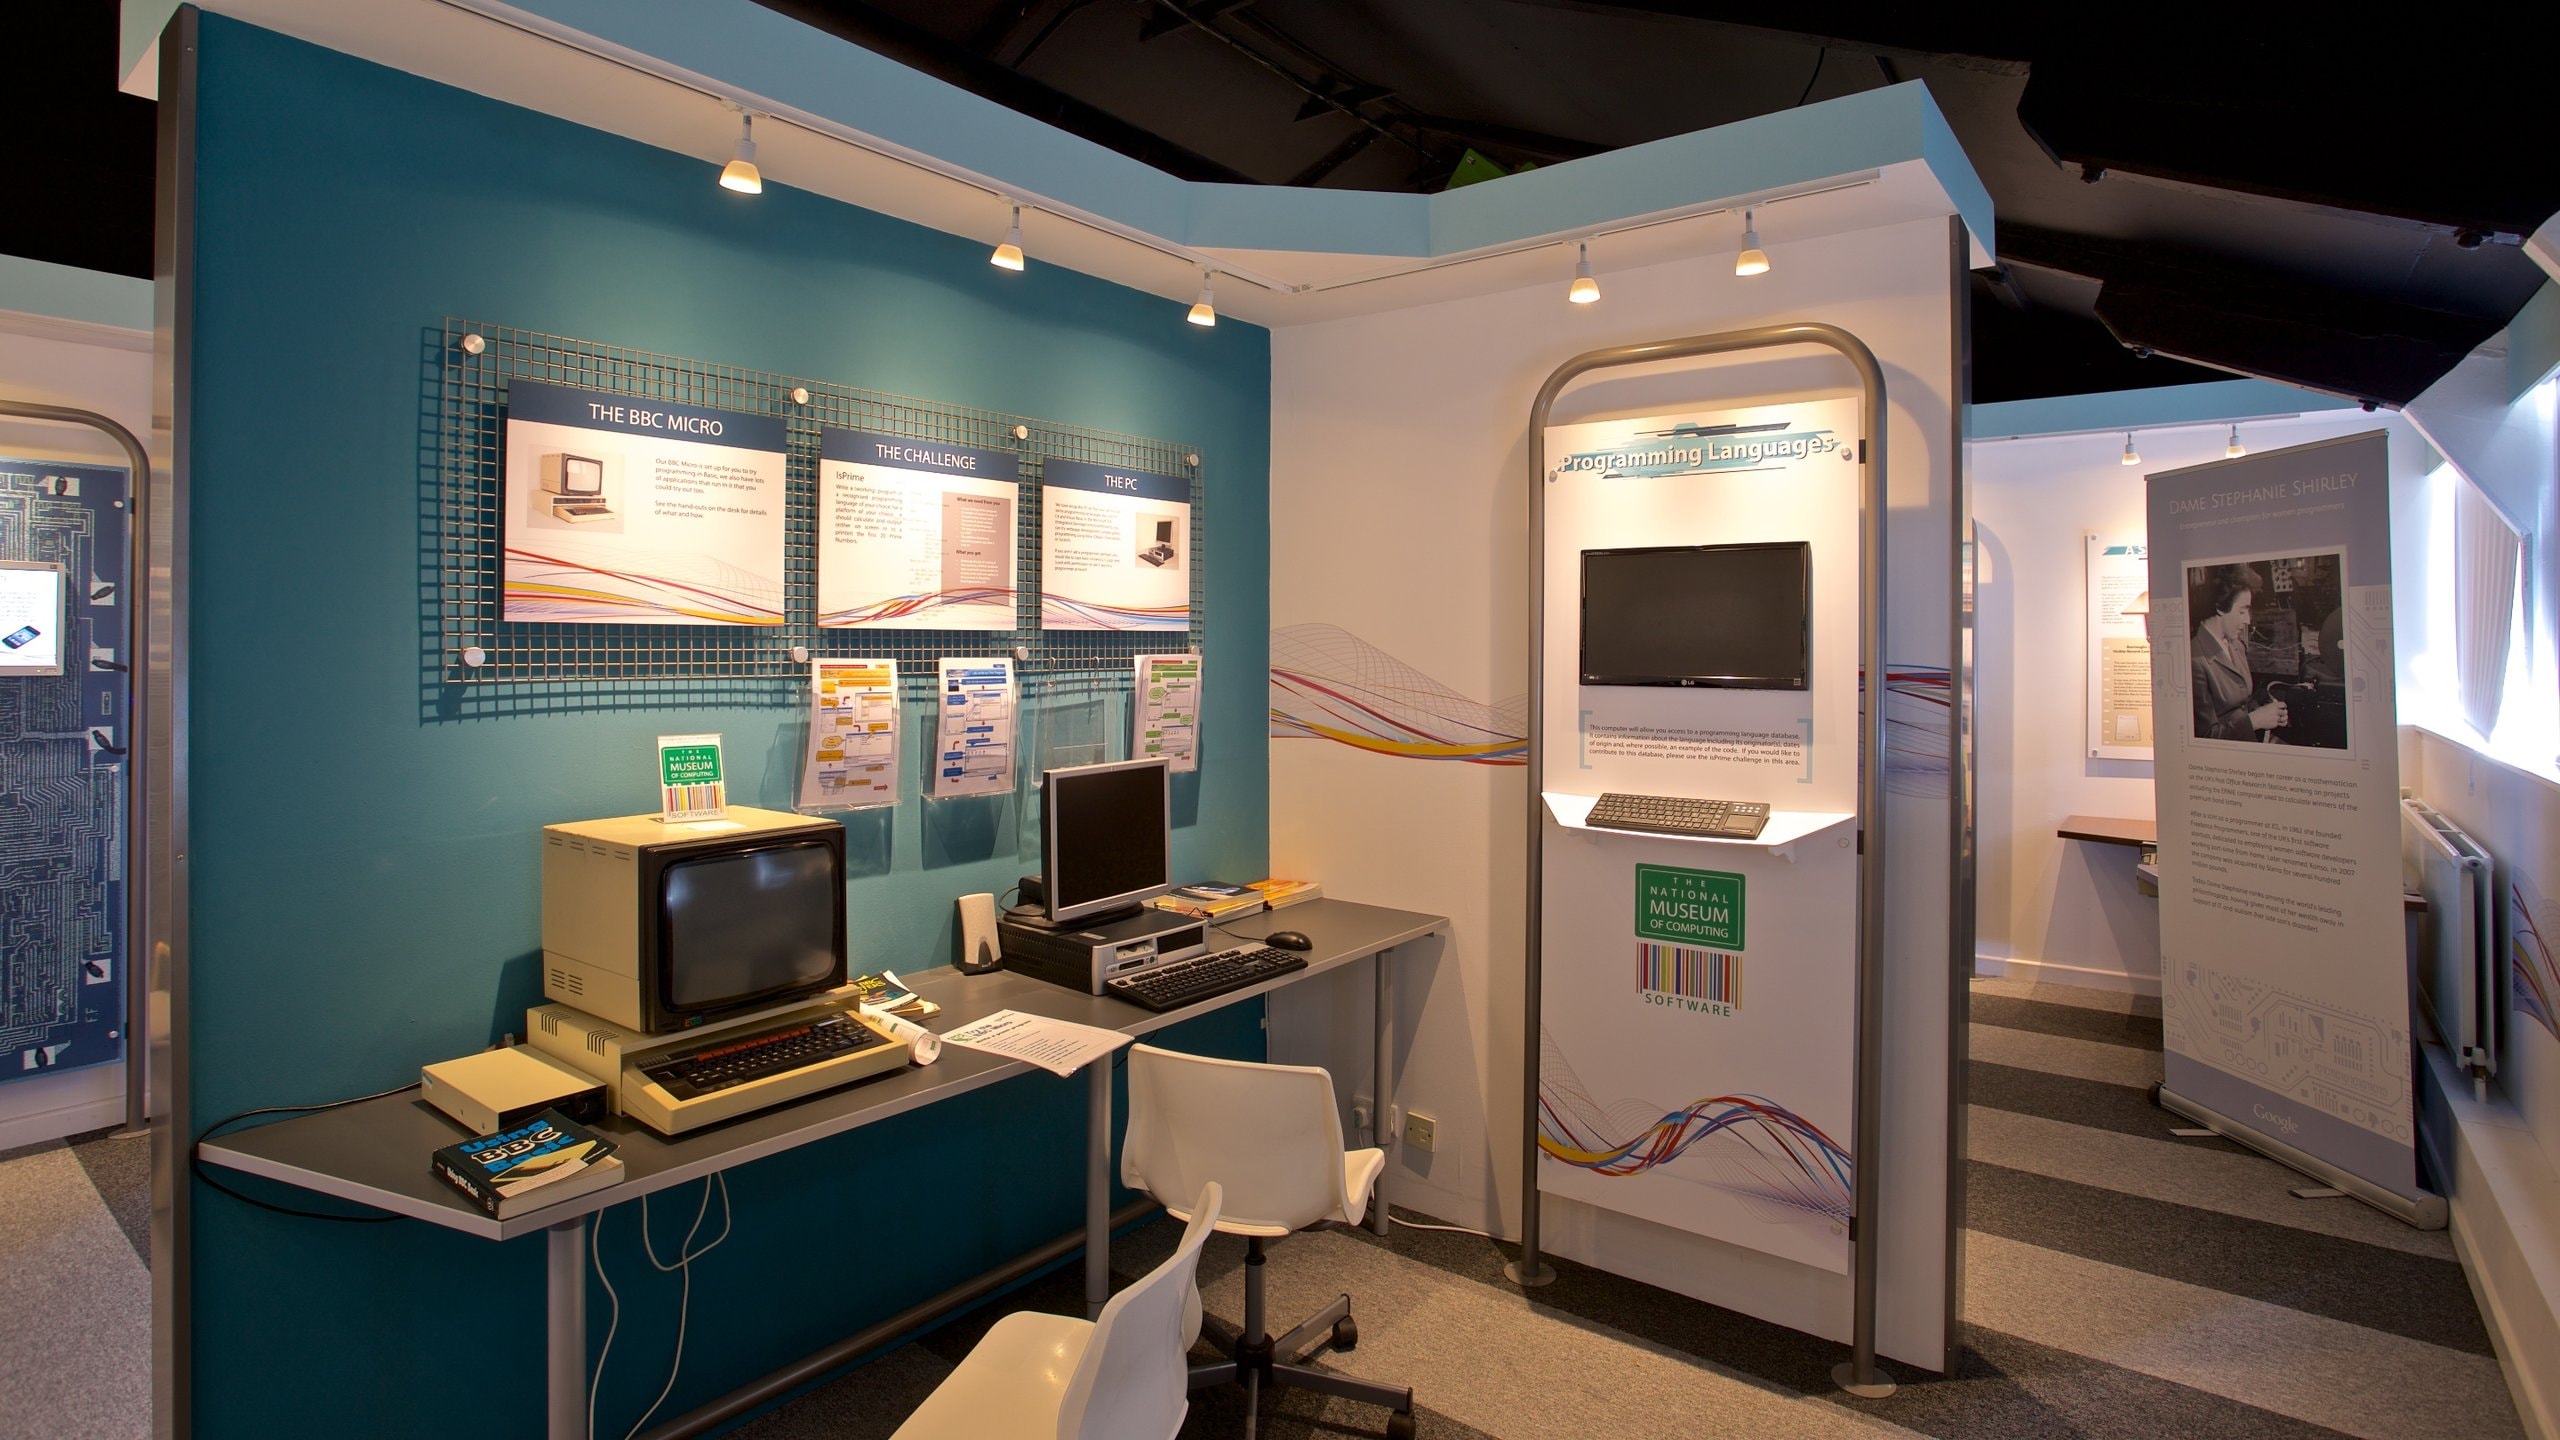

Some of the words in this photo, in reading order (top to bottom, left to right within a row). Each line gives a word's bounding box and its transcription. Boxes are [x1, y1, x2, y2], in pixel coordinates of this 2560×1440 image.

[589, 404, 624, 423] THE
[630, 409, 663, 429] BBC
[668, 415, 722, 436] MICRO
[876, 444, 901, 460] THE
[904, 448, 976, 470] CHALLENGE
[1561, 445, 1702, 474] Programming
[1708, 436, 1834, 462] Languages
[836, 472, 864, 482] IsPrime
[1105, 475, 1122, 488] THE
[1125, 478, 1137, 490] PC
[2170, 497, 2205, 514] DAME
[2211, 484, 2286, 508] STEPHANIE
[2293, 473, 2358, 496] SHIRLEY
[670, 762, 713, 771] MUSEUM
[672, 810, 718, 818] SOFTWARE
[1650, 886, 1728, 904] NATIONAL
[1674, 878, 1705, 887] THE
[1650, 899, 1729, 924] MUSEUM
[1650, 919, 1664, 928] OF
[1666, 921, 1728, 938] COMPUTING
[1645, 994, 1730, 1017] SOFTWARE
[2253, 1103, 2299, 1134] Google
[460, 1119, 550, 1152] Using
[471, 1126, 562, 1164] BBC
[484, 1135, 576, 1172] Basic
